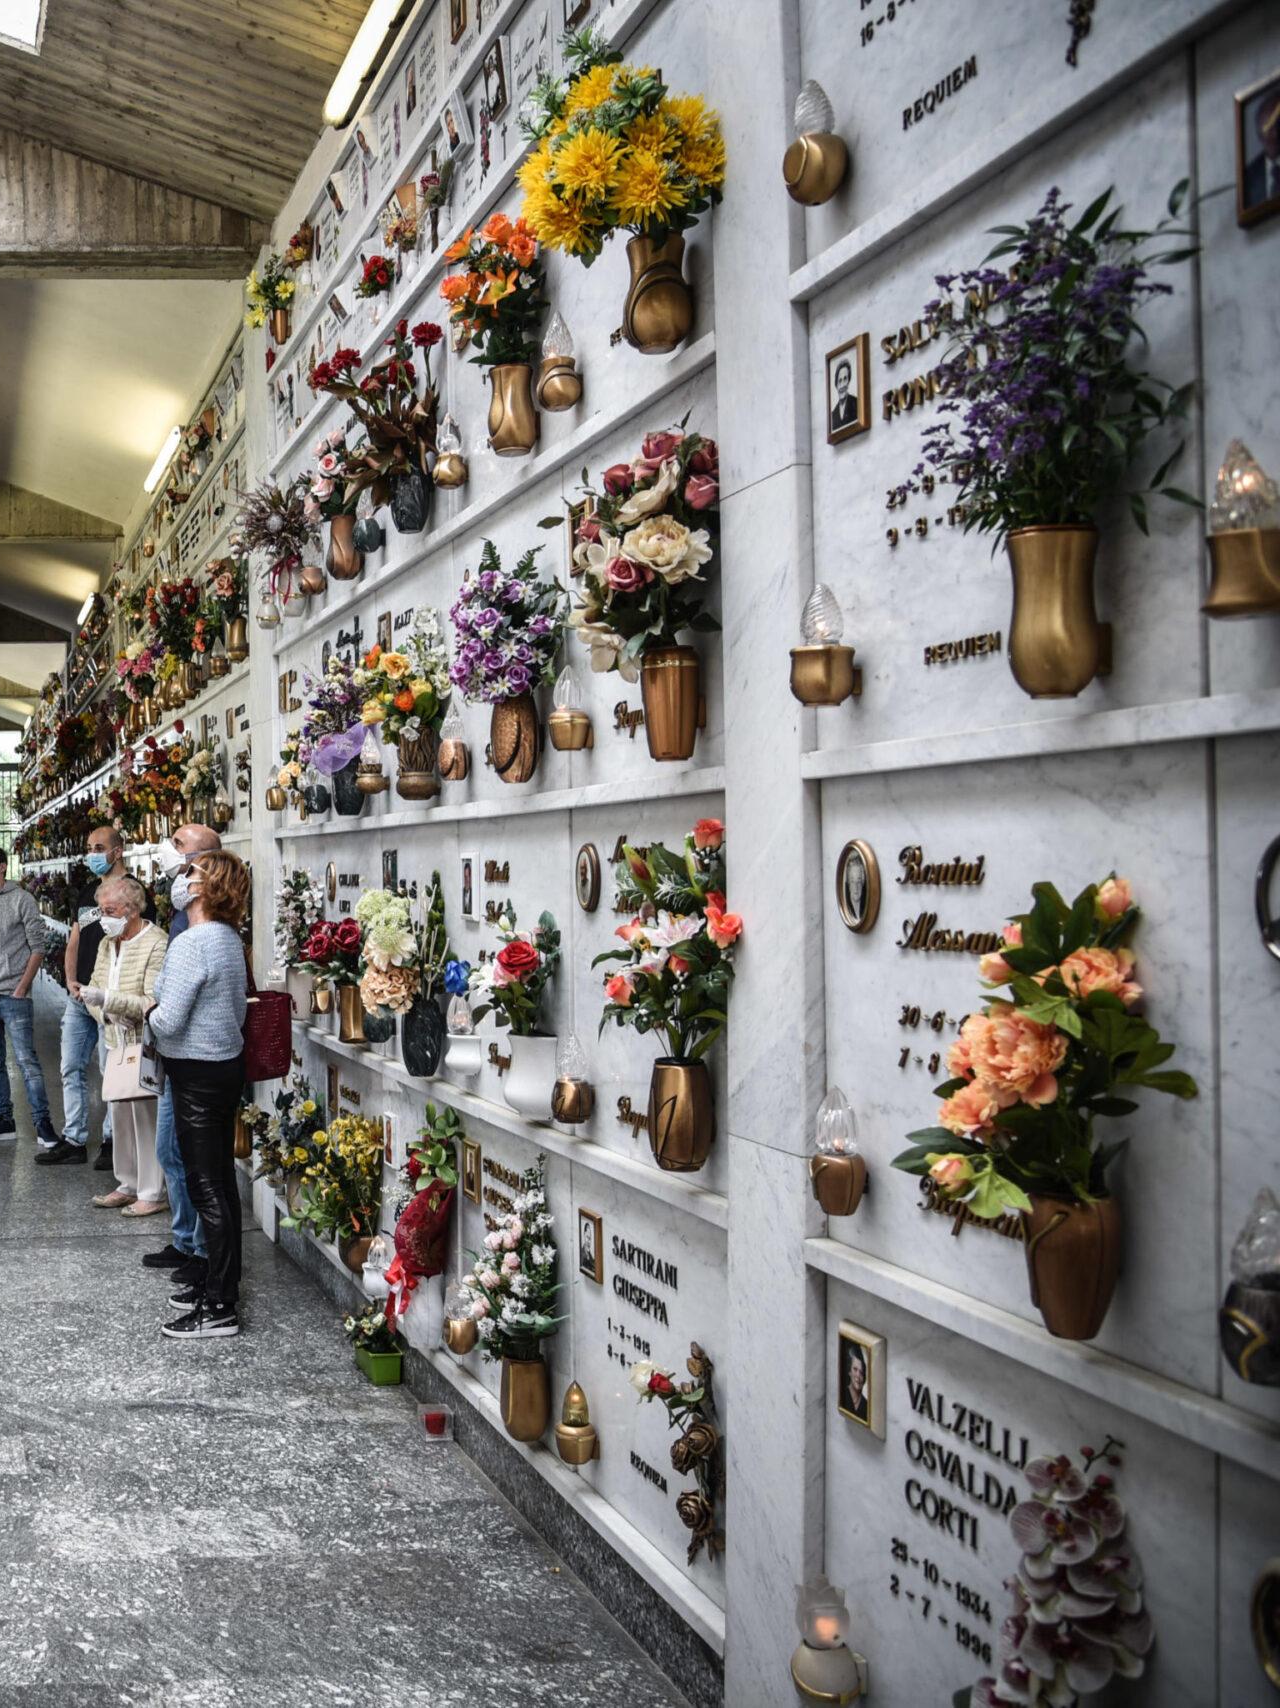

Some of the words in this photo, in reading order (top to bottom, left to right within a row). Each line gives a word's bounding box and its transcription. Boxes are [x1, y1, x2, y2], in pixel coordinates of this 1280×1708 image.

[902, 55, 978, 130] REQUIEM
[923, 630, 1002, 666] REQUIEM
[612, 1234, 678, 1292] SARTIRANI
[613, 1274, 669, 1328] GIUSEPPA
[906, 1377, 1029, 1471] VALZELLI
[630, 1450, 668, 1494] REQUIEM
[905, 1429, 1017, 1516] OSVALDA
[905, 1478, 978, 1552] CORTI
